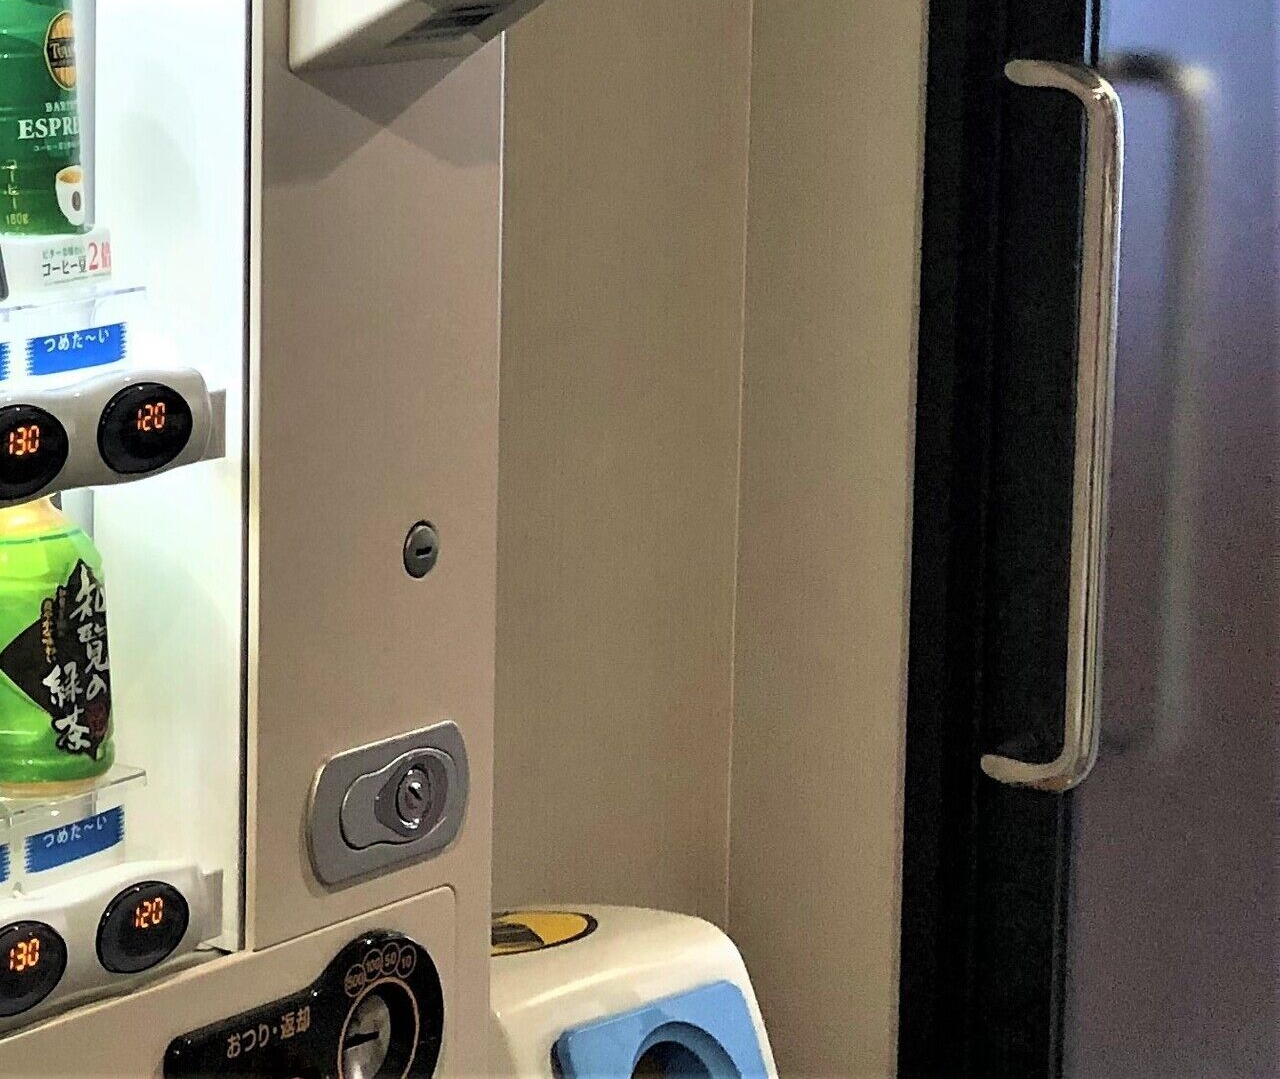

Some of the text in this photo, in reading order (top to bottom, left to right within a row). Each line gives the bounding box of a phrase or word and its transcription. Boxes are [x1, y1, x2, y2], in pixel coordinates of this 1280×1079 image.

[135, 400, 167, 432] 120
[8, 424, 41, 455] 130
[69, 563, 110, 702] 知覧の
[42, 662, 91, 751] 緑茶
[132, 896, 163, 927] 120
[8, 939, 40, 971] 130
[226, 1006, 310, 1058] おつり・返却
